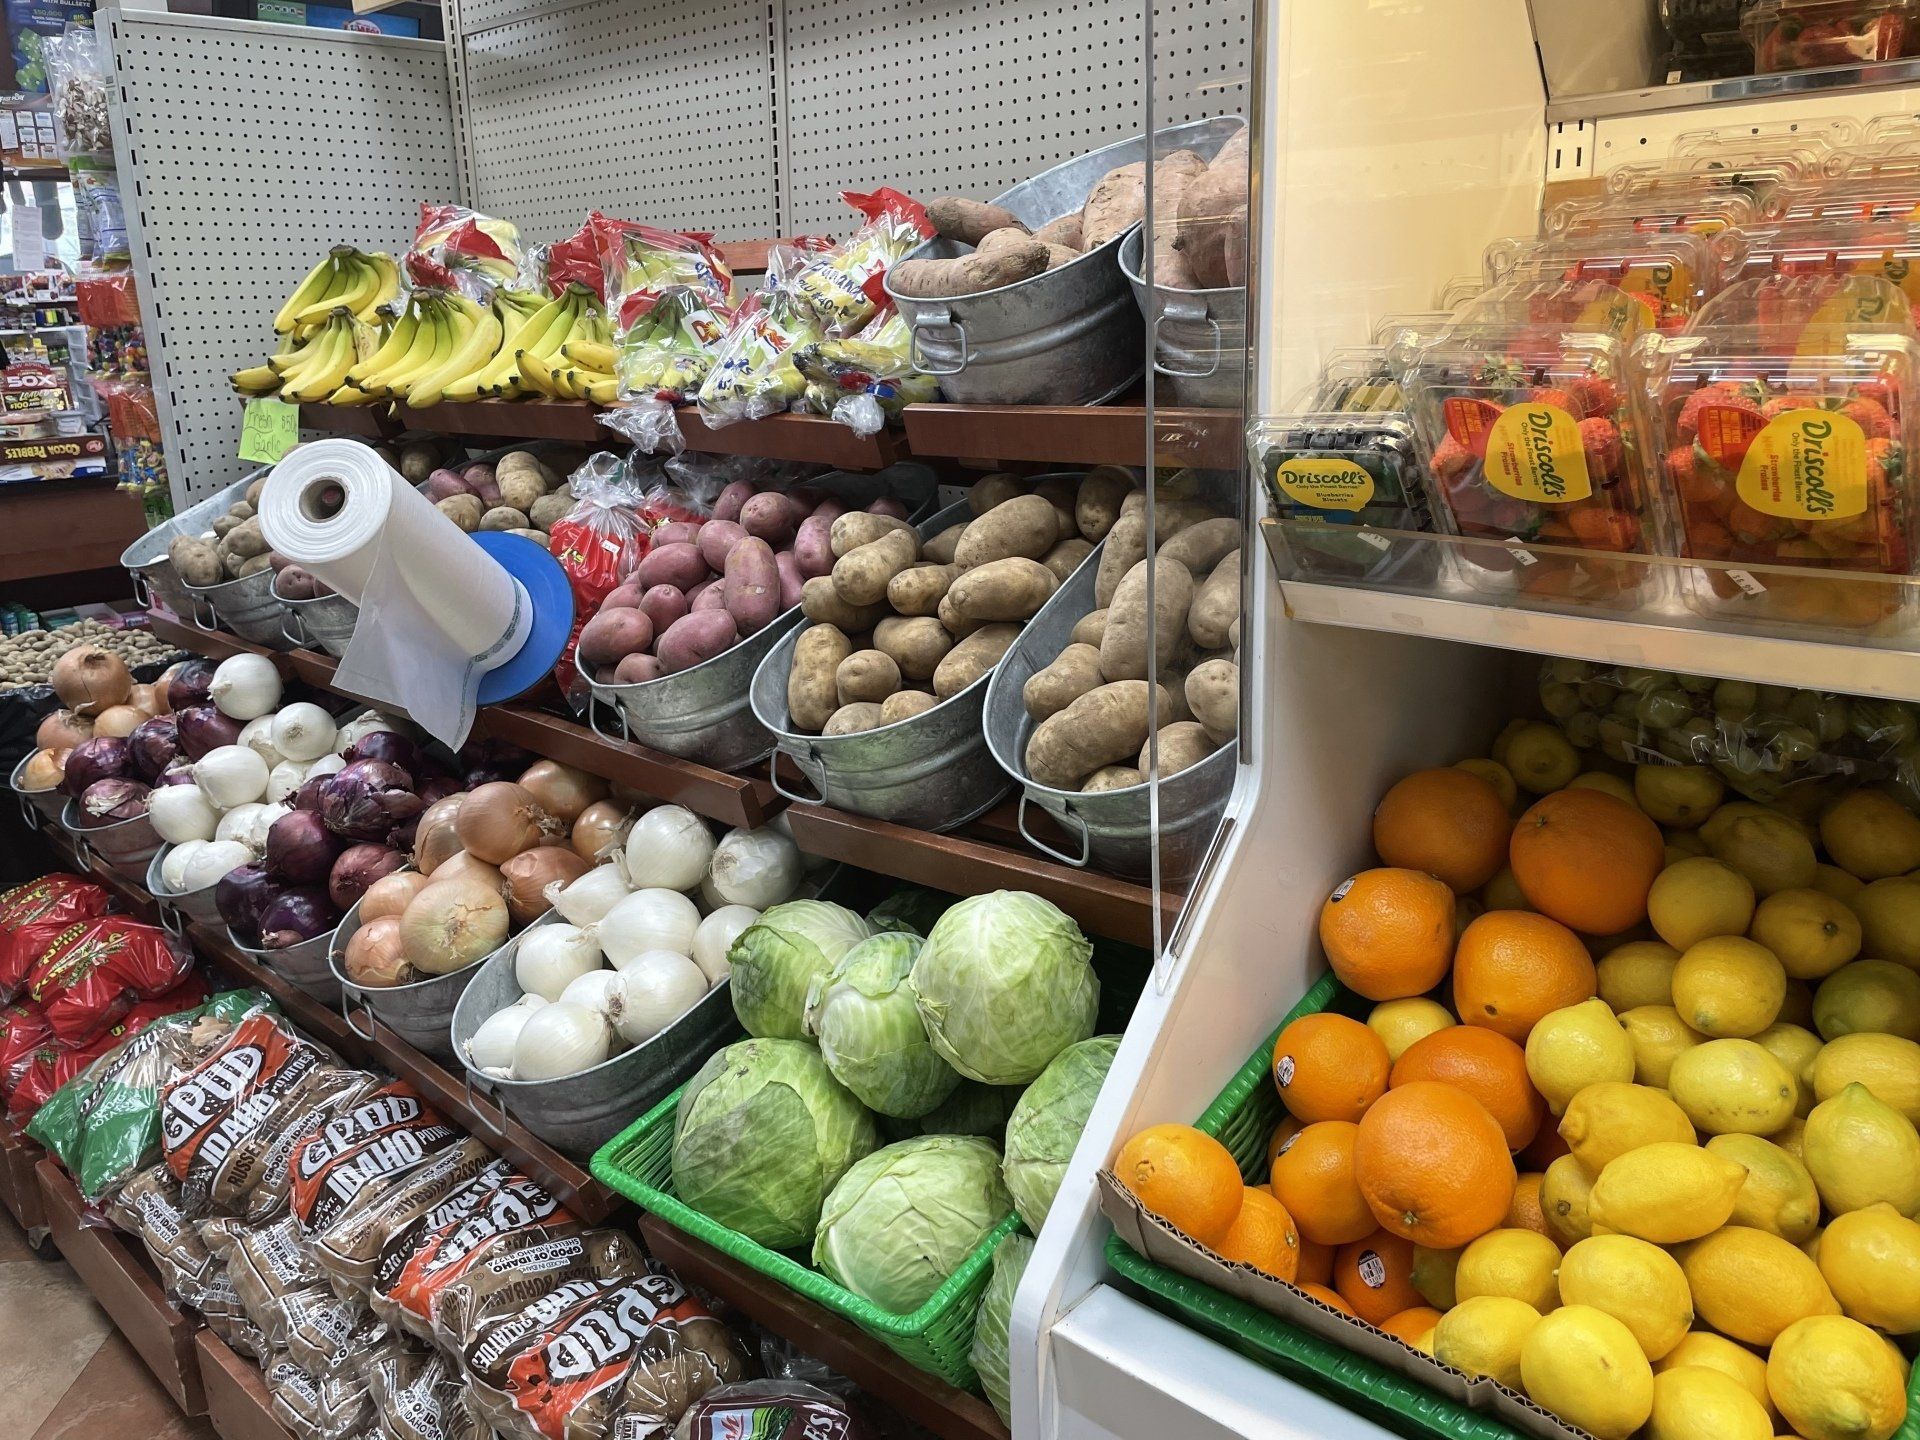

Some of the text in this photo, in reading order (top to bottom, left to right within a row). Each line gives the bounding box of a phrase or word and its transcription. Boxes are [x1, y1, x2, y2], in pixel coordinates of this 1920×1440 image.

[5, 446, 47, 459] PEBBLES
[1500, 451, 1512, 476] Fraises
[1507, 442, 1523, 487] Strawberries
[1528, 411, 1566, 498] Driscoll's
[1802, 420, 1835, 515] Driscoll's
[1281, 470, 1366, 486] Driscoll's
[1760, 464, 1769, 491] Fraises
[1769, 454, 1782, 503] Strawberries
[162, 1046, 263, 1149] GPOD
[199, 1053, 316, 1168] IDAHO POTATOES
[264, 1111, 317, 1181] GPOD OF IDAHO
[302, 1096, 419, 1177] GPOD
[227, 1141, 265, 1188] RUSSET
[326, 1130, 424, 1204] IDAHO
[330, 1205, 342, 1216] kg
[493, 1245, 582, 1273] GPOD OF IDAHO
[517, 1246, 545, 1258] IDAHO
[471, 1315, 533, 1375] POTATOES
[548, 1275, 686, 1379] GPOD
[404, 1410, 427, 1433] IDAHO
